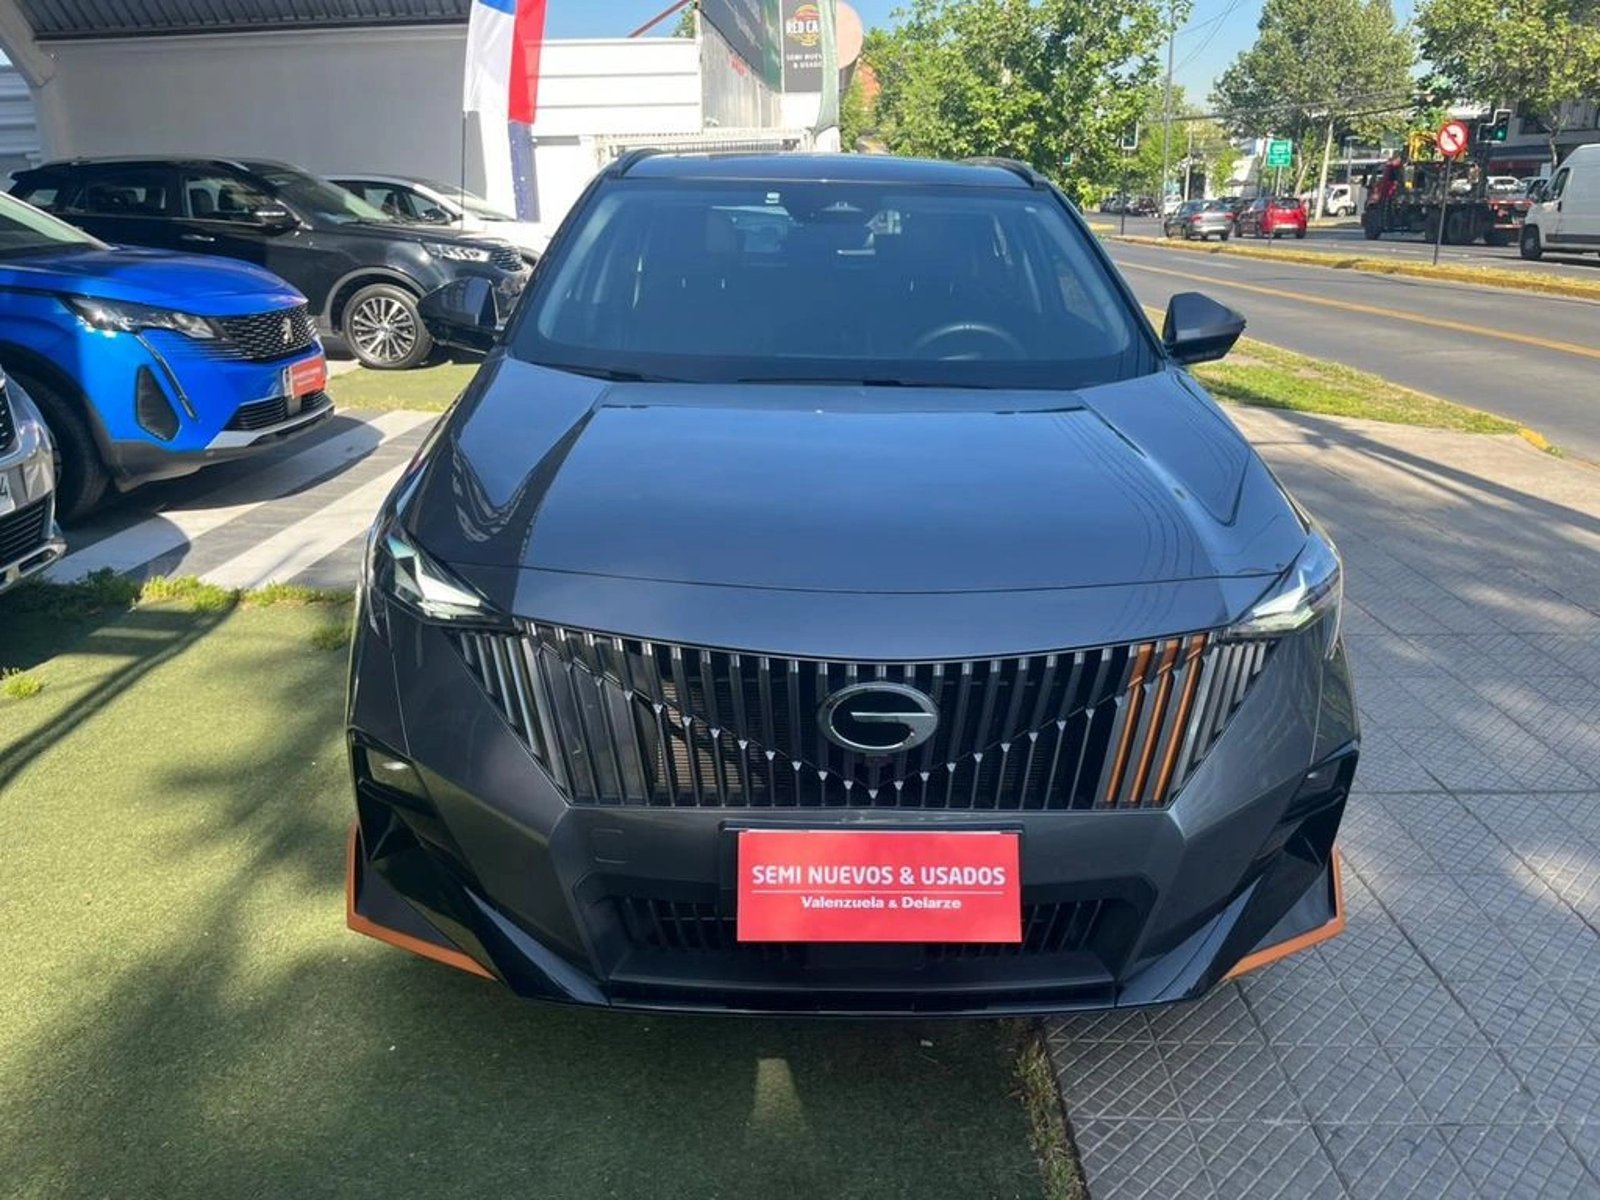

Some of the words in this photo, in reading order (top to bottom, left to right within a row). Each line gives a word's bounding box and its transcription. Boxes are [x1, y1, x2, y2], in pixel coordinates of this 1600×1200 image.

[786, 19, 804, 34] RED
[751, 865, 801, 885] SEMI
[808, 865, 894, 885] NUEVOS
[899, 866, 915, 886] &
[920, 866, 1006, 886] USADOS
[800, 895, 884, 909] Valenzuela
[888, 899, 898, 909] &
[901, 896, 962, 909] Delarze
